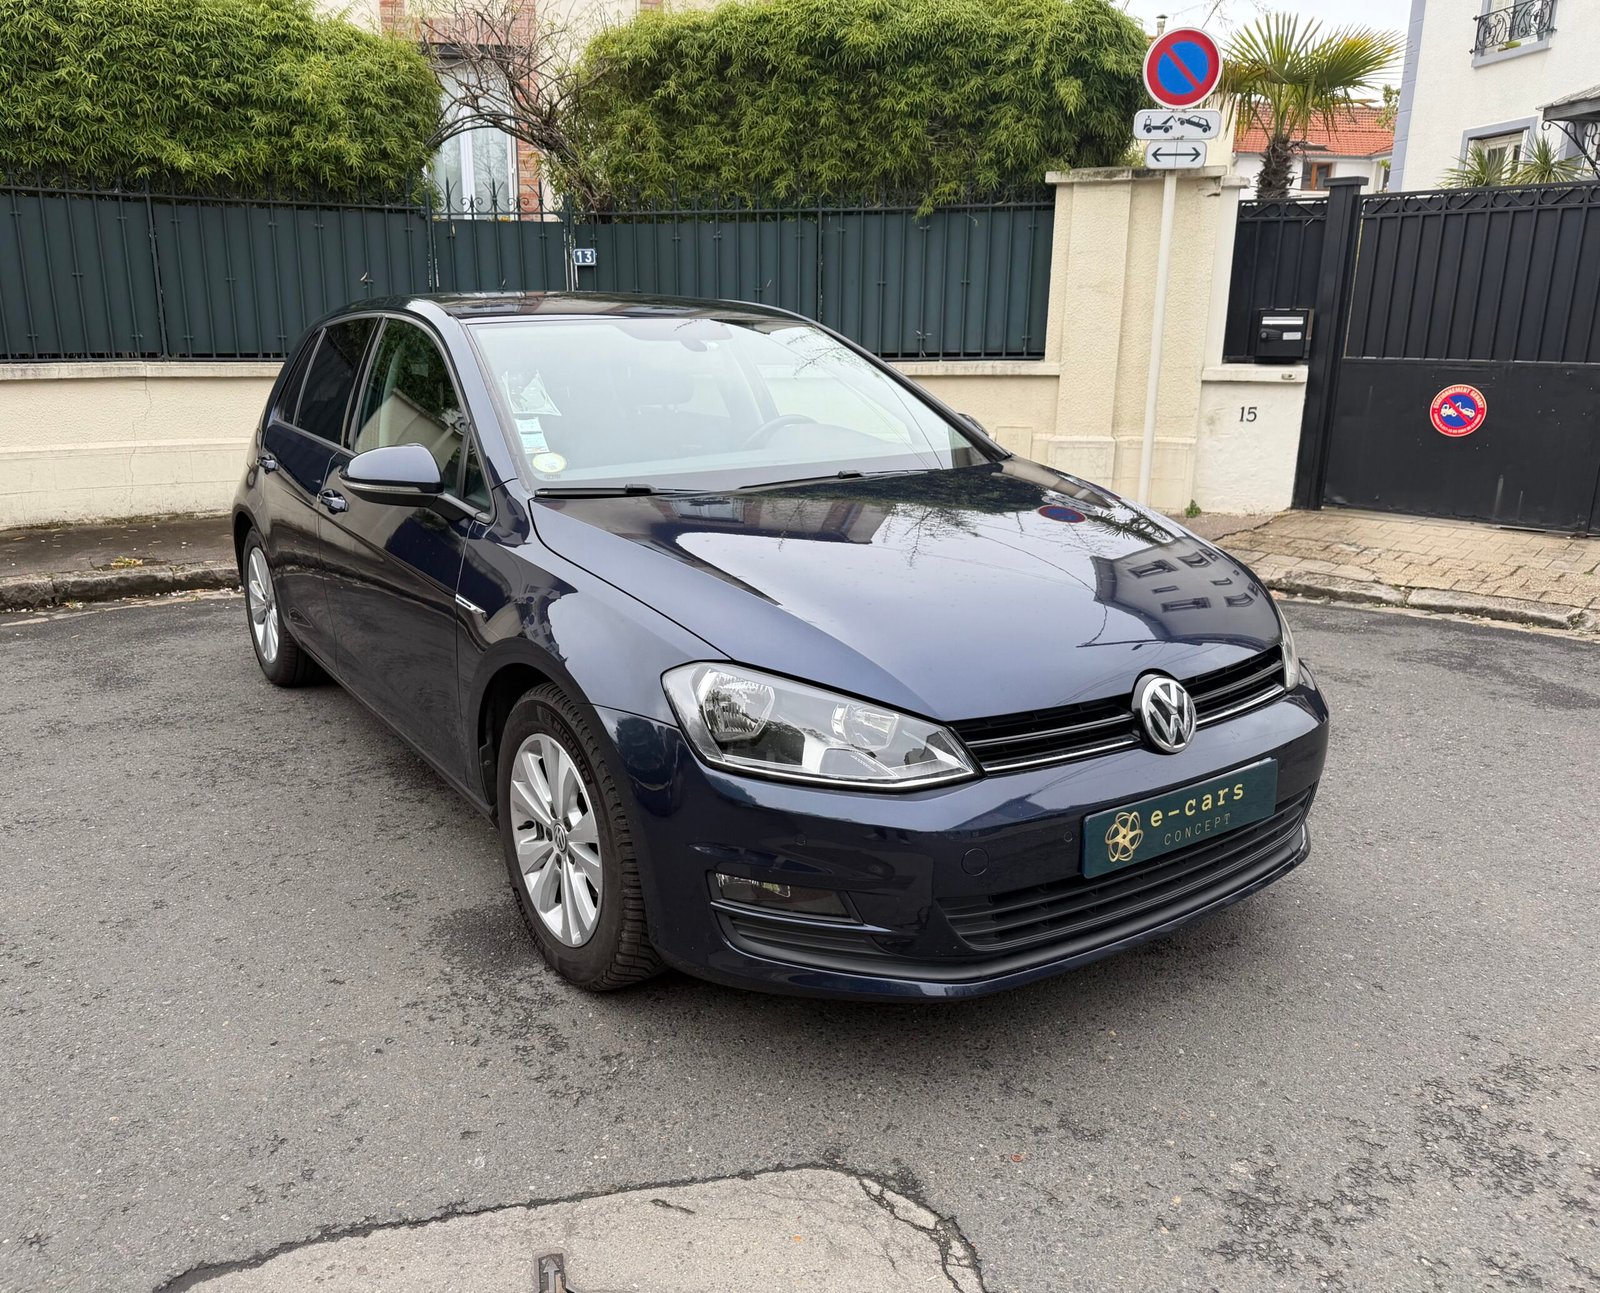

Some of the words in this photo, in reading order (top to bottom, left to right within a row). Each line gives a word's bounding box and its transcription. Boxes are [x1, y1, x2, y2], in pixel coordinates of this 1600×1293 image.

[576, 250, 592, 263] 13
[1239, 406, 1258, 423] 15
[1141, 677, 1197, 753] VW
[552, 720, 591, 782] MICHELIN
[1150, 783, 1244, 827] e-cars
[1164, 812, 1232, 846] CONCEPT
